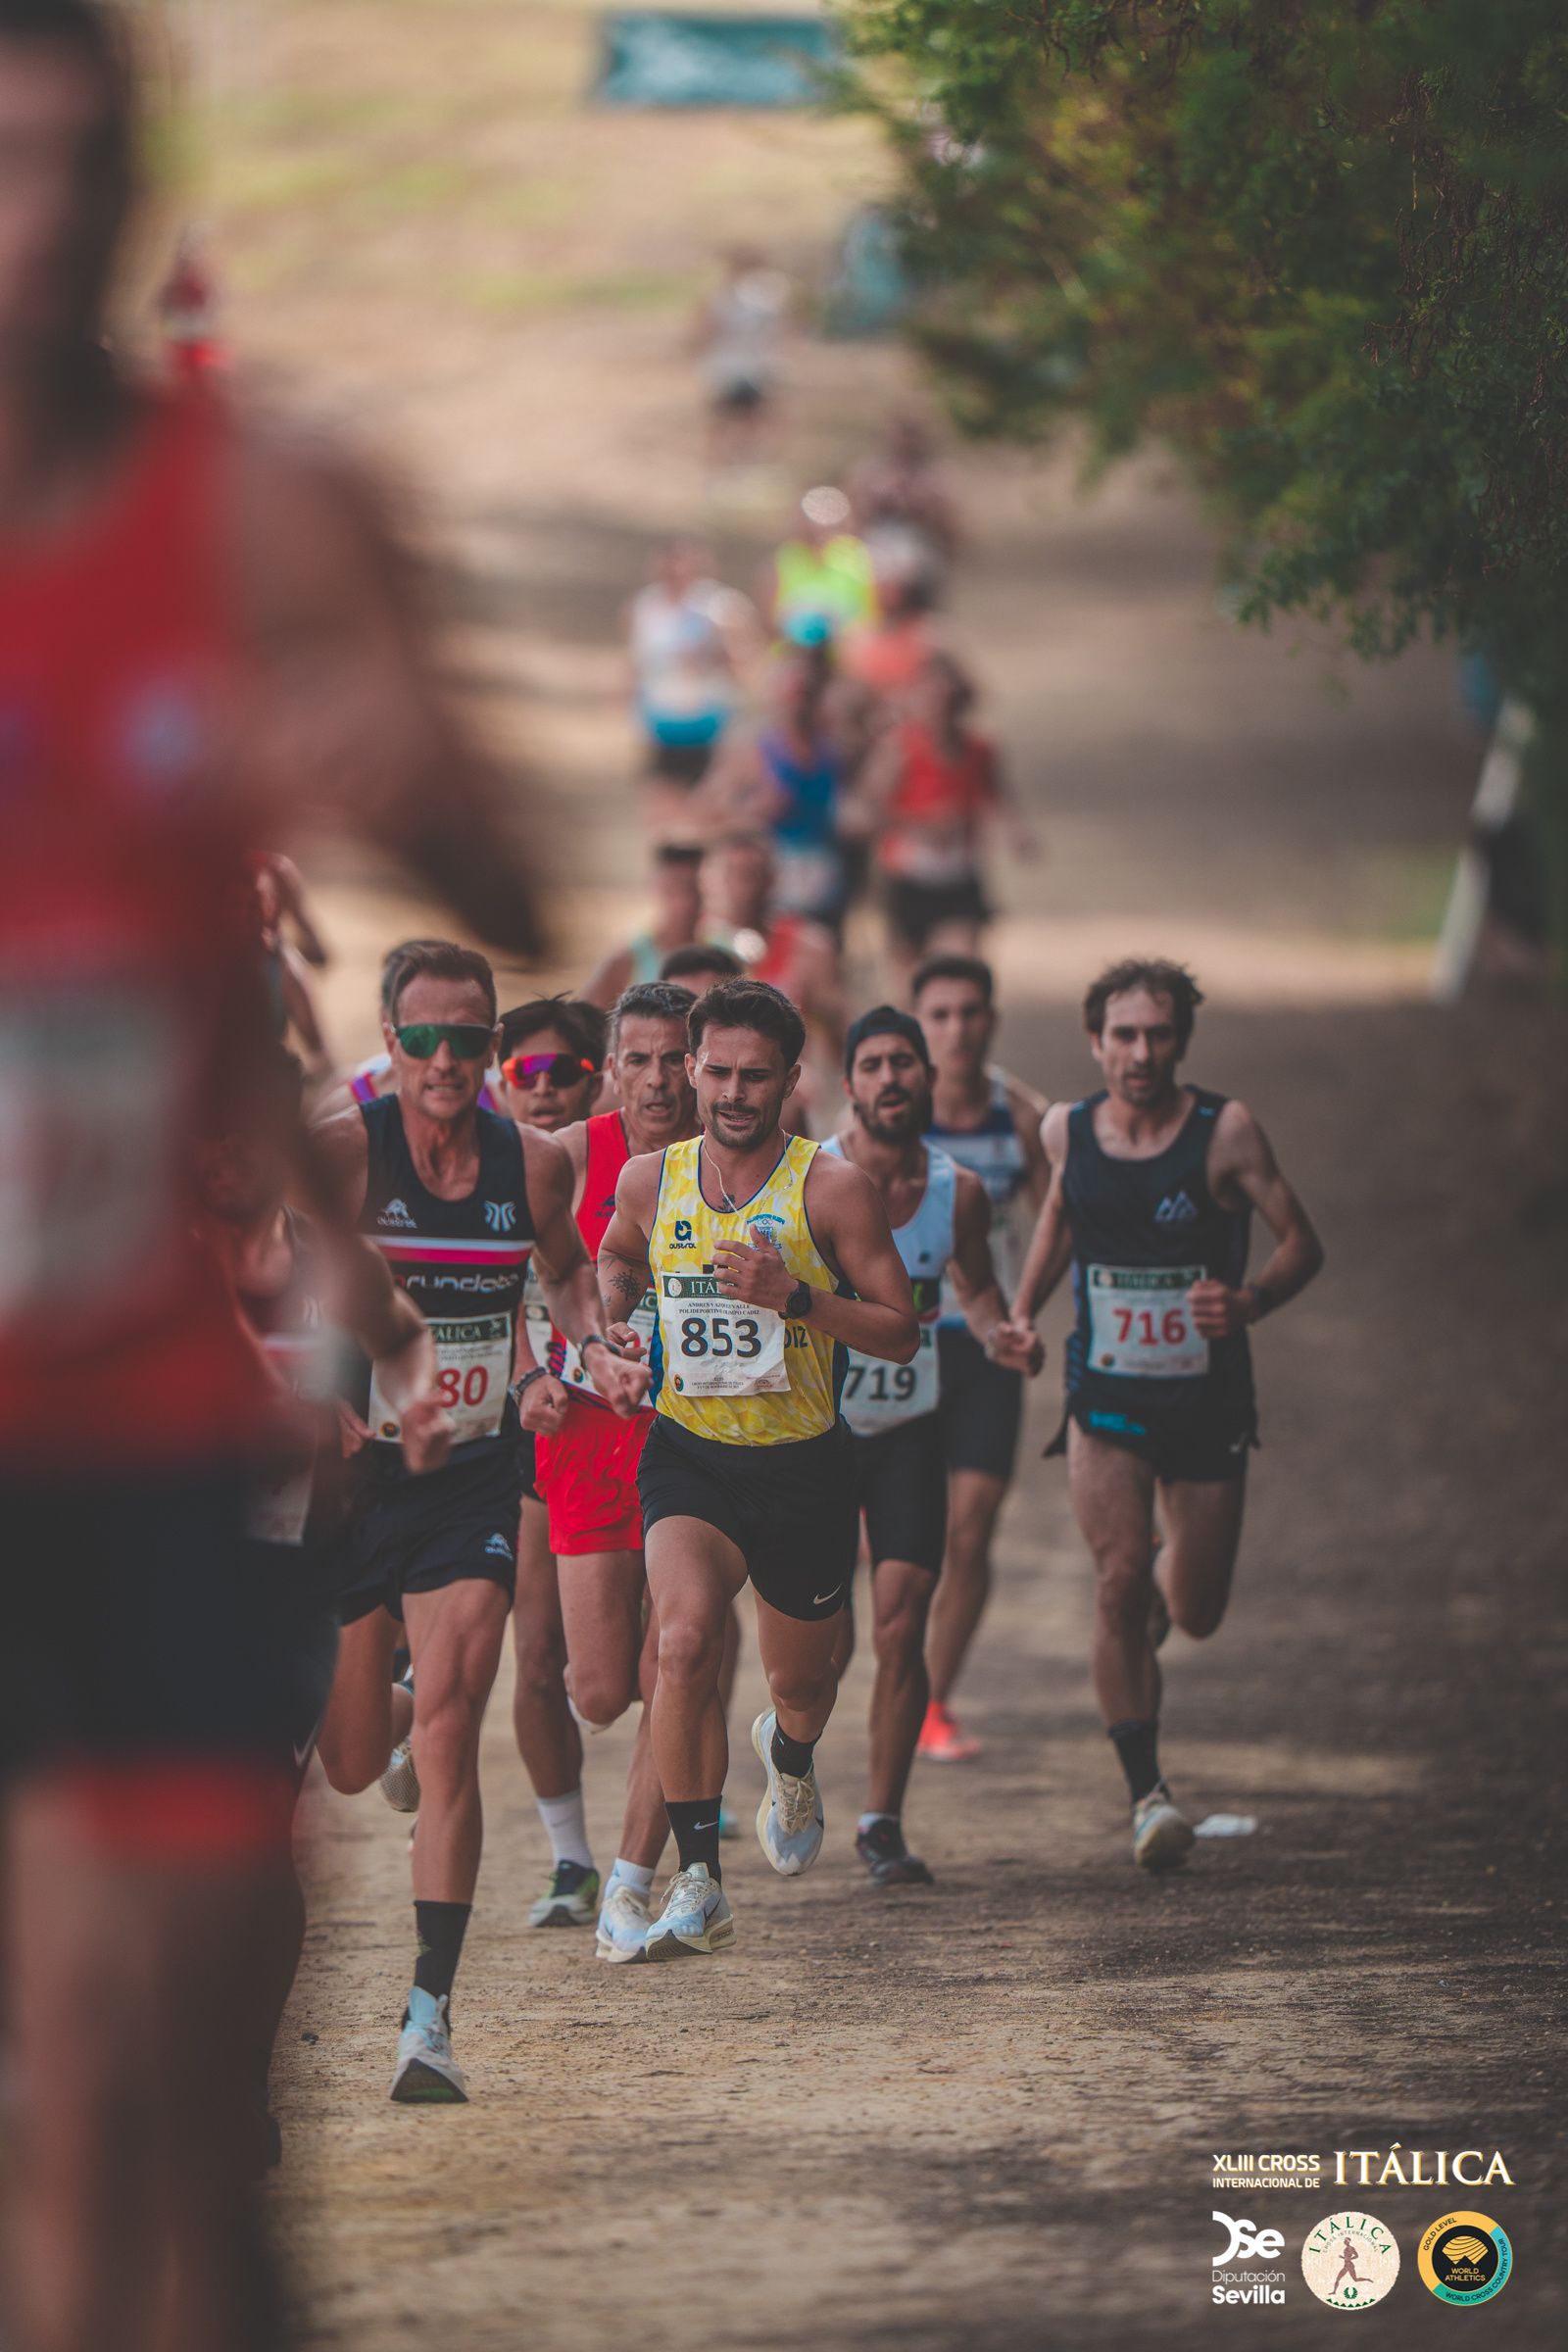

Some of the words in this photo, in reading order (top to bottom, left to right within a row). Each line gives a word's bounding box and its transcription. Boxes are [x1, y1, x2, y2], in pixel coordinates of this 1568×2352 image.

[681, 1317, 761, 1358] 853
[784, 1326, 808, 1348] DIZ
[1112, 1308, 1187, 1347] 716
[437, 1364, 488, 1408] 80
[845, 1366, 917, 1401] 719
